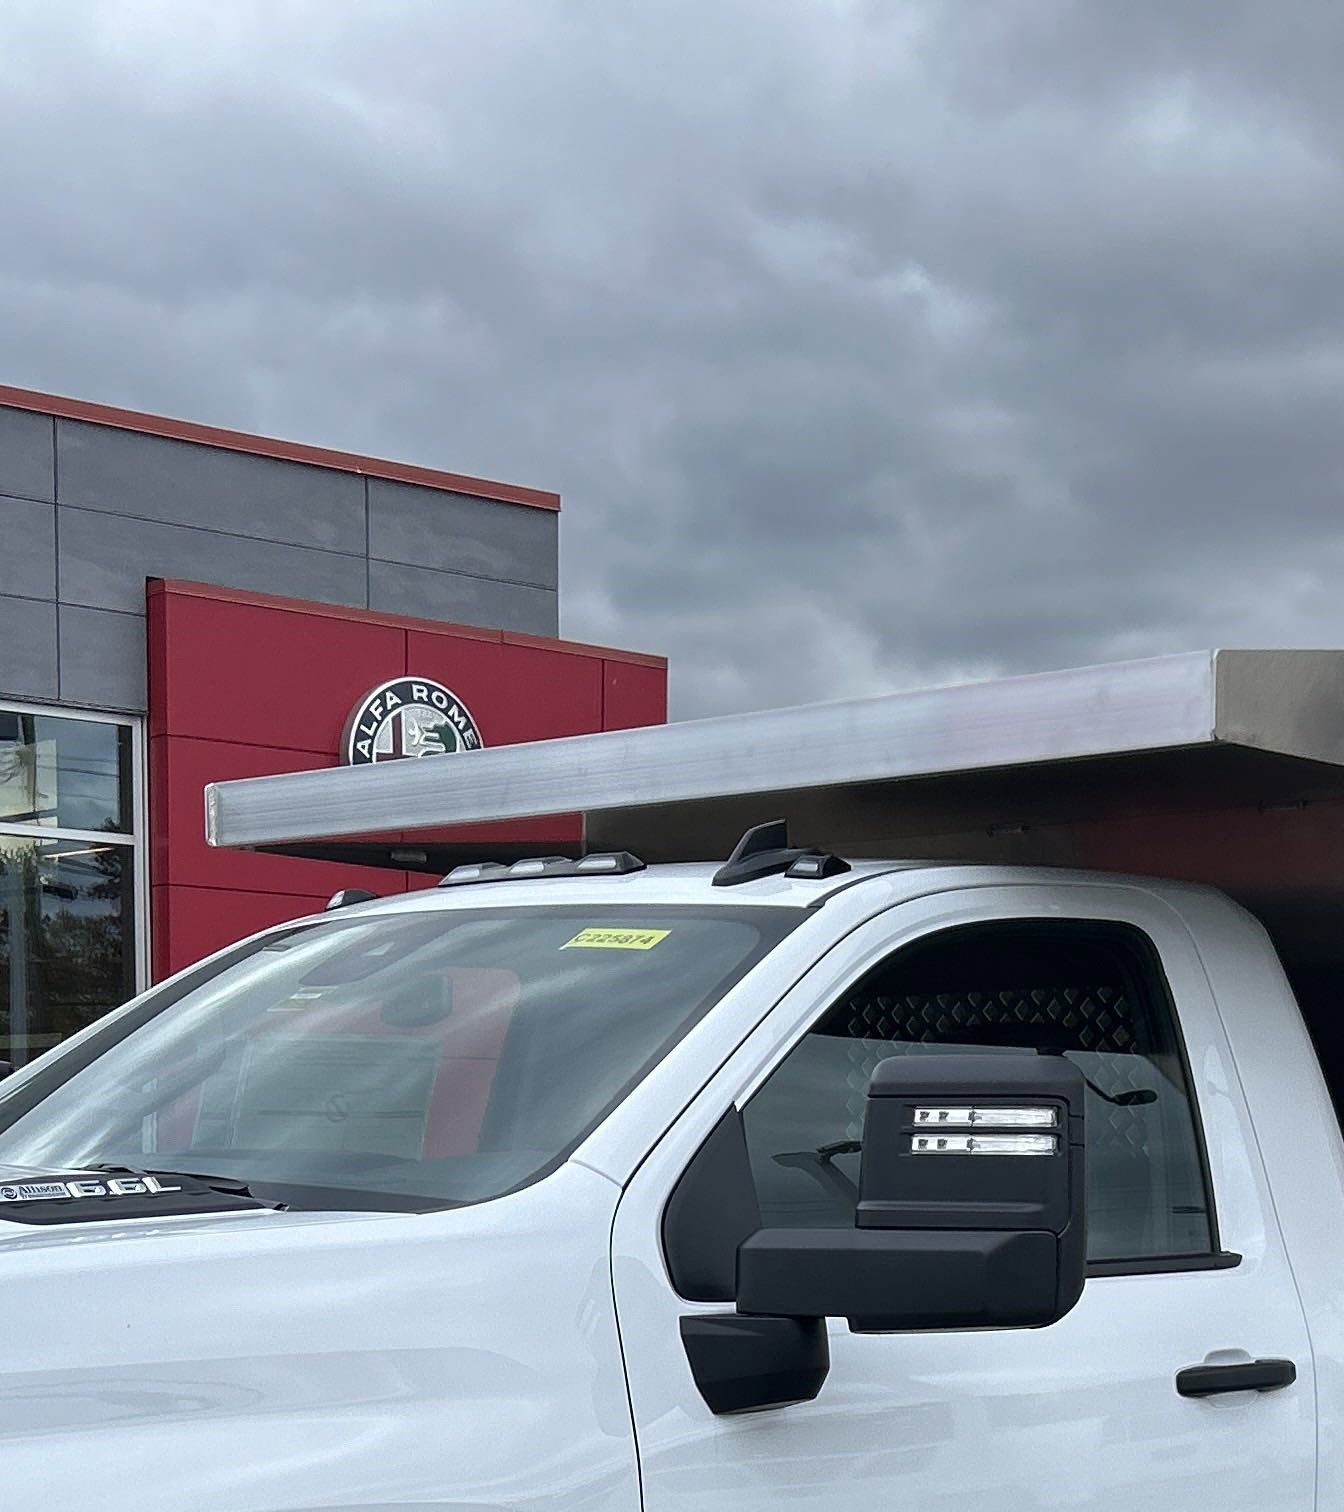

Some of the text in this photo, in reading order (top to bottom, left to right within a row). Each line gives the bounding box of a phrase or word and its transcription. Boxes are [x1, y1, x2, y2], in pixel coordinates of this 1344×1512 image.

[356, 683, 478, 759] ALFA ROME
[66, 1176, 182, 1198] 6.6L
